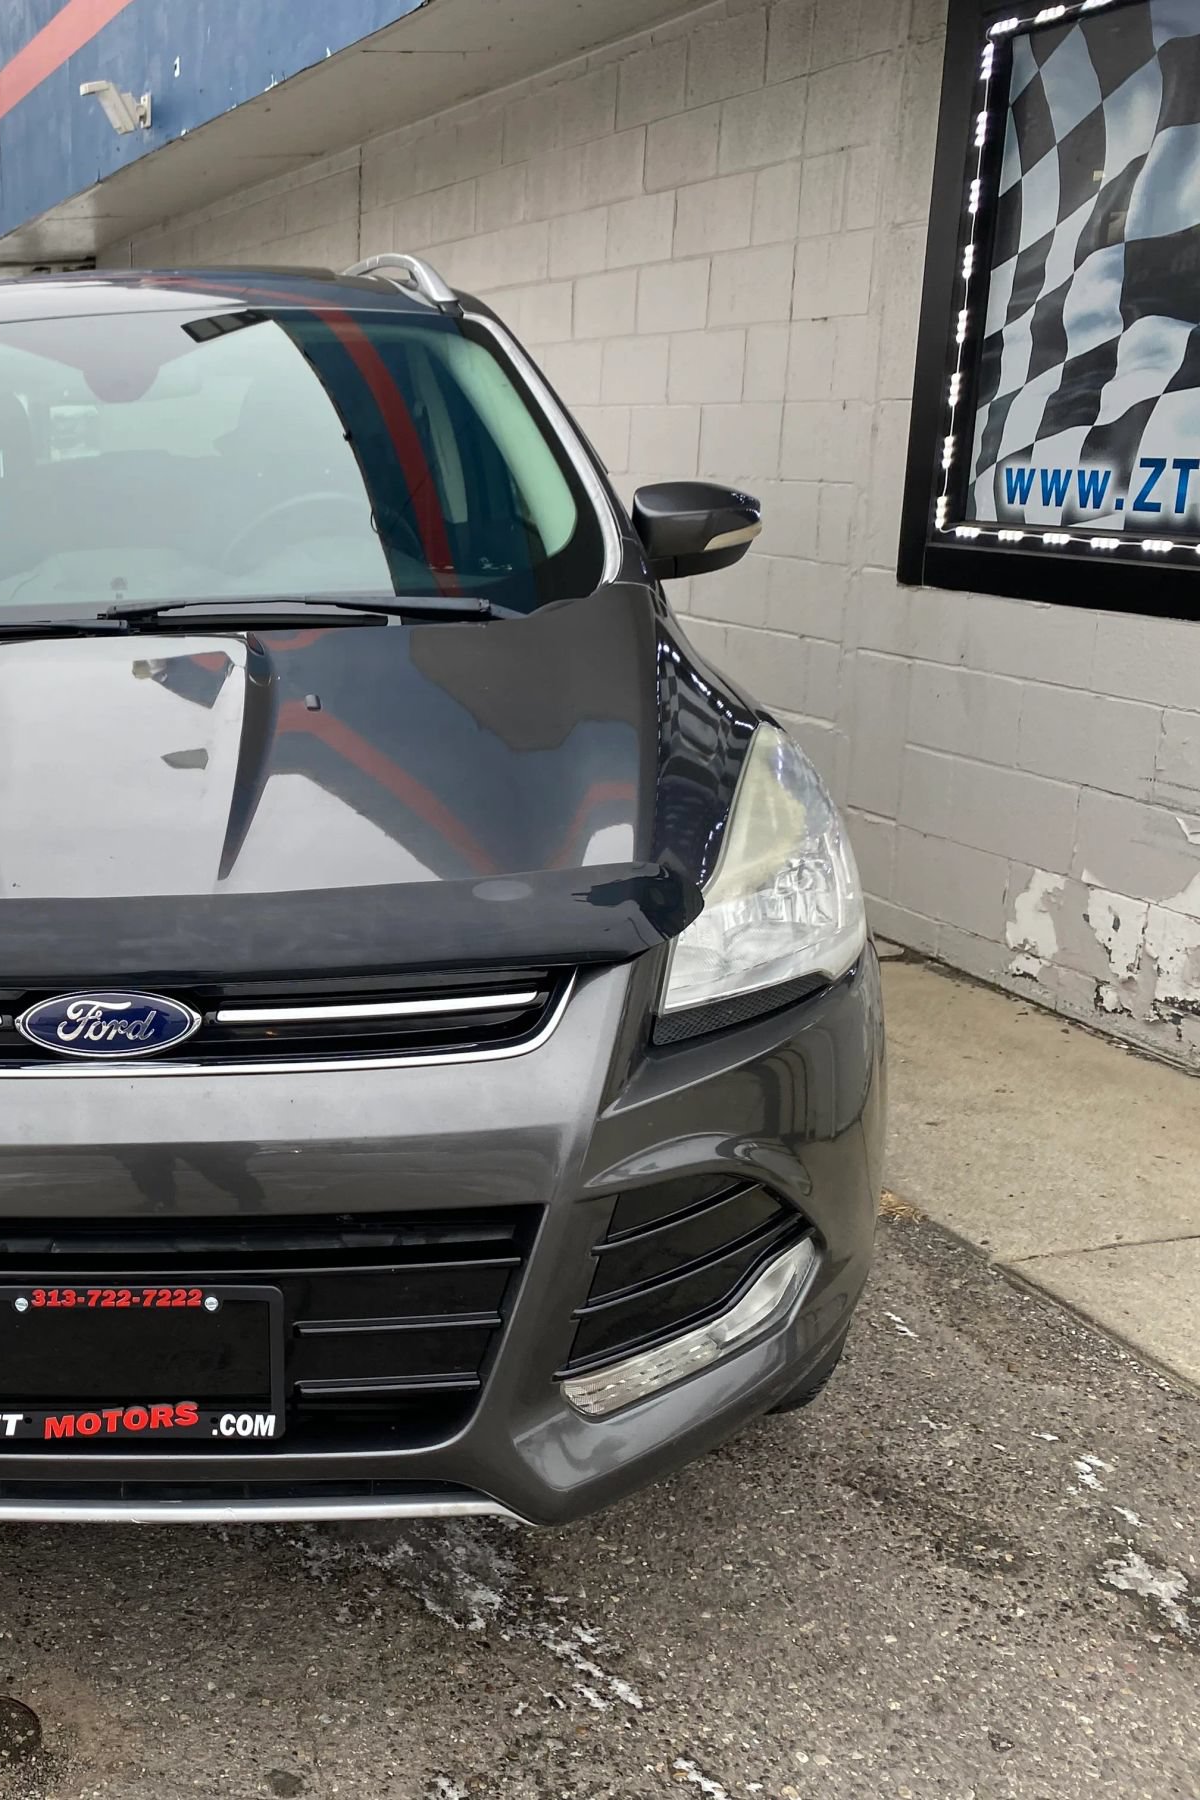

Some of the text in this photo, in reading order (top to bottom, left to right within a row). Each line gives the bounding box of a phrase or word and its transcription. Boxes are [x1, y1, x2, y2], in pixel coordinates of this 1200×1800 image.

[56, 1000, 157, 1041] Ford
[31, 1288, 203, 1307] 313-722-7222
[44, 1401, 199, 1440] MOTORS
[211, 1413, 276, 1437] .COM
